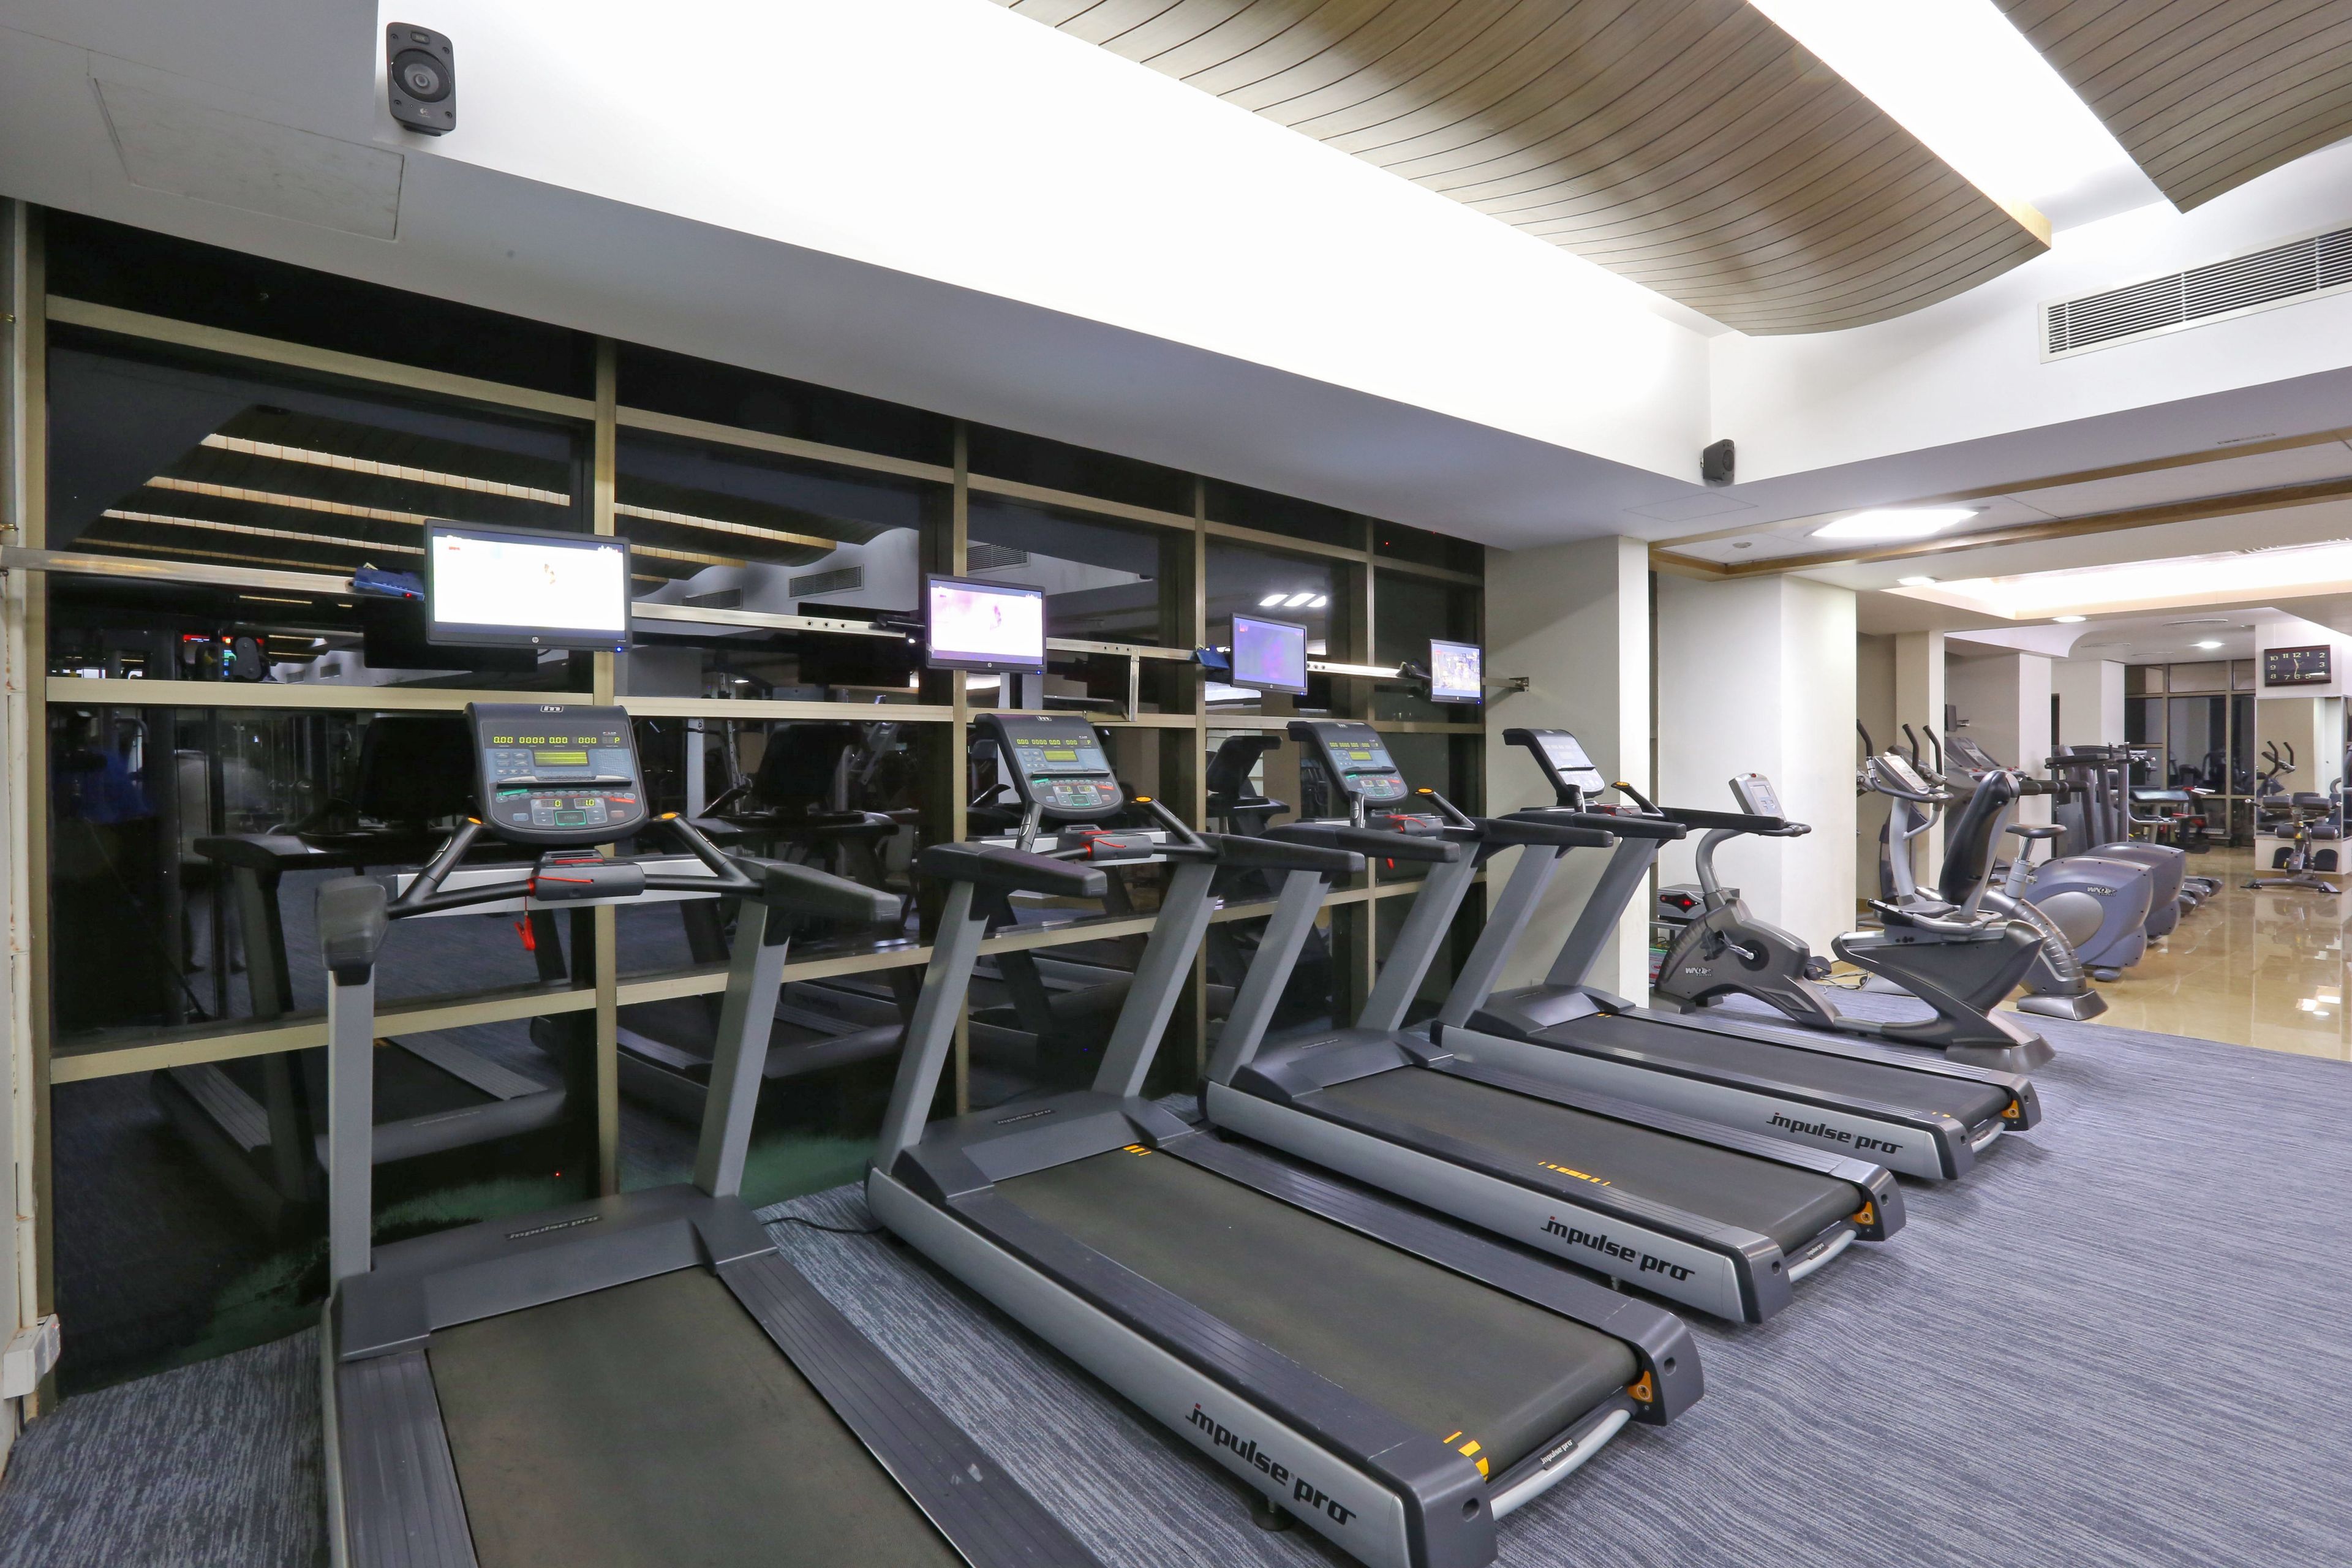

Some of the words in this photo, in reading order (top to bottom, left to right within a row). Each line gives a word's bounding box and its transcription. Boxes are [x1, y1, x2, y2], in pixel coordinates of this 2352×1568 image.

[1766, 1112, 1852, 1144] impulse
[1855, 1136, 1903, 1154] pro
[1540, 1216, 1636, 1263] impulse
[1640, 1254, 1695, 1281] pro
[1185, 1403, 1289, 1487] impulse
[1293, 1477, 1357, 1525] pro
[1540, 1447, 1563, 1465] impulse
[1561, 1439, 1573, 1452] pro
